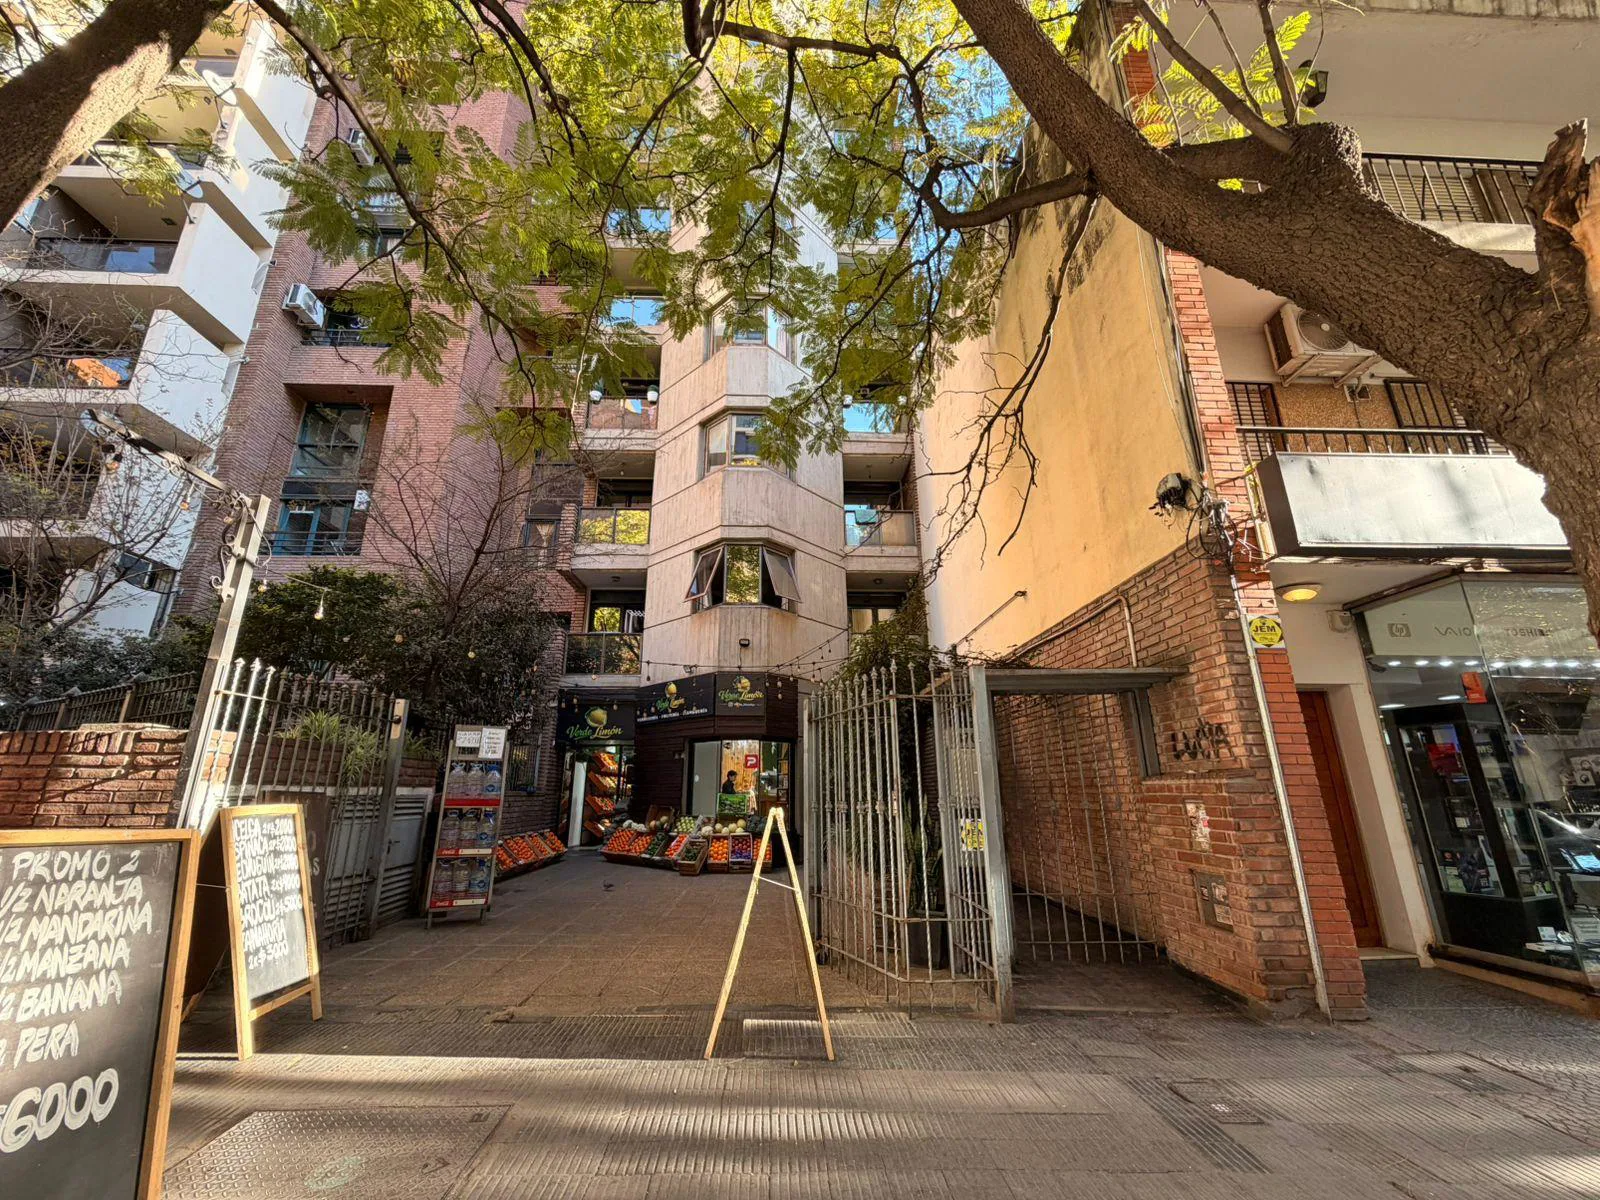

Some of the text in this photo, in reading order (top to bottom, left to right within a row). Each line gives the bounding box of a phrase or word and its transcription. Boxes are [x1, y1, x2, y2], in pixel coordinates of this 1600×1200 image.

[1253, 625, 1276, 633] JEM
[1434, 626, 1472, 637] VAIO
[590, 725, 624, 739] Limón
[12, 850, 140, 882] PROMO 2
[33, 875, 143, 914] NARANJA
[20, 901, 152, 952] MANDARINA
[16, 938, 130, 982] MANZANA
[16, 969, 122, 1023] BANANA
[14, 1020, 79, 1069] PERA
